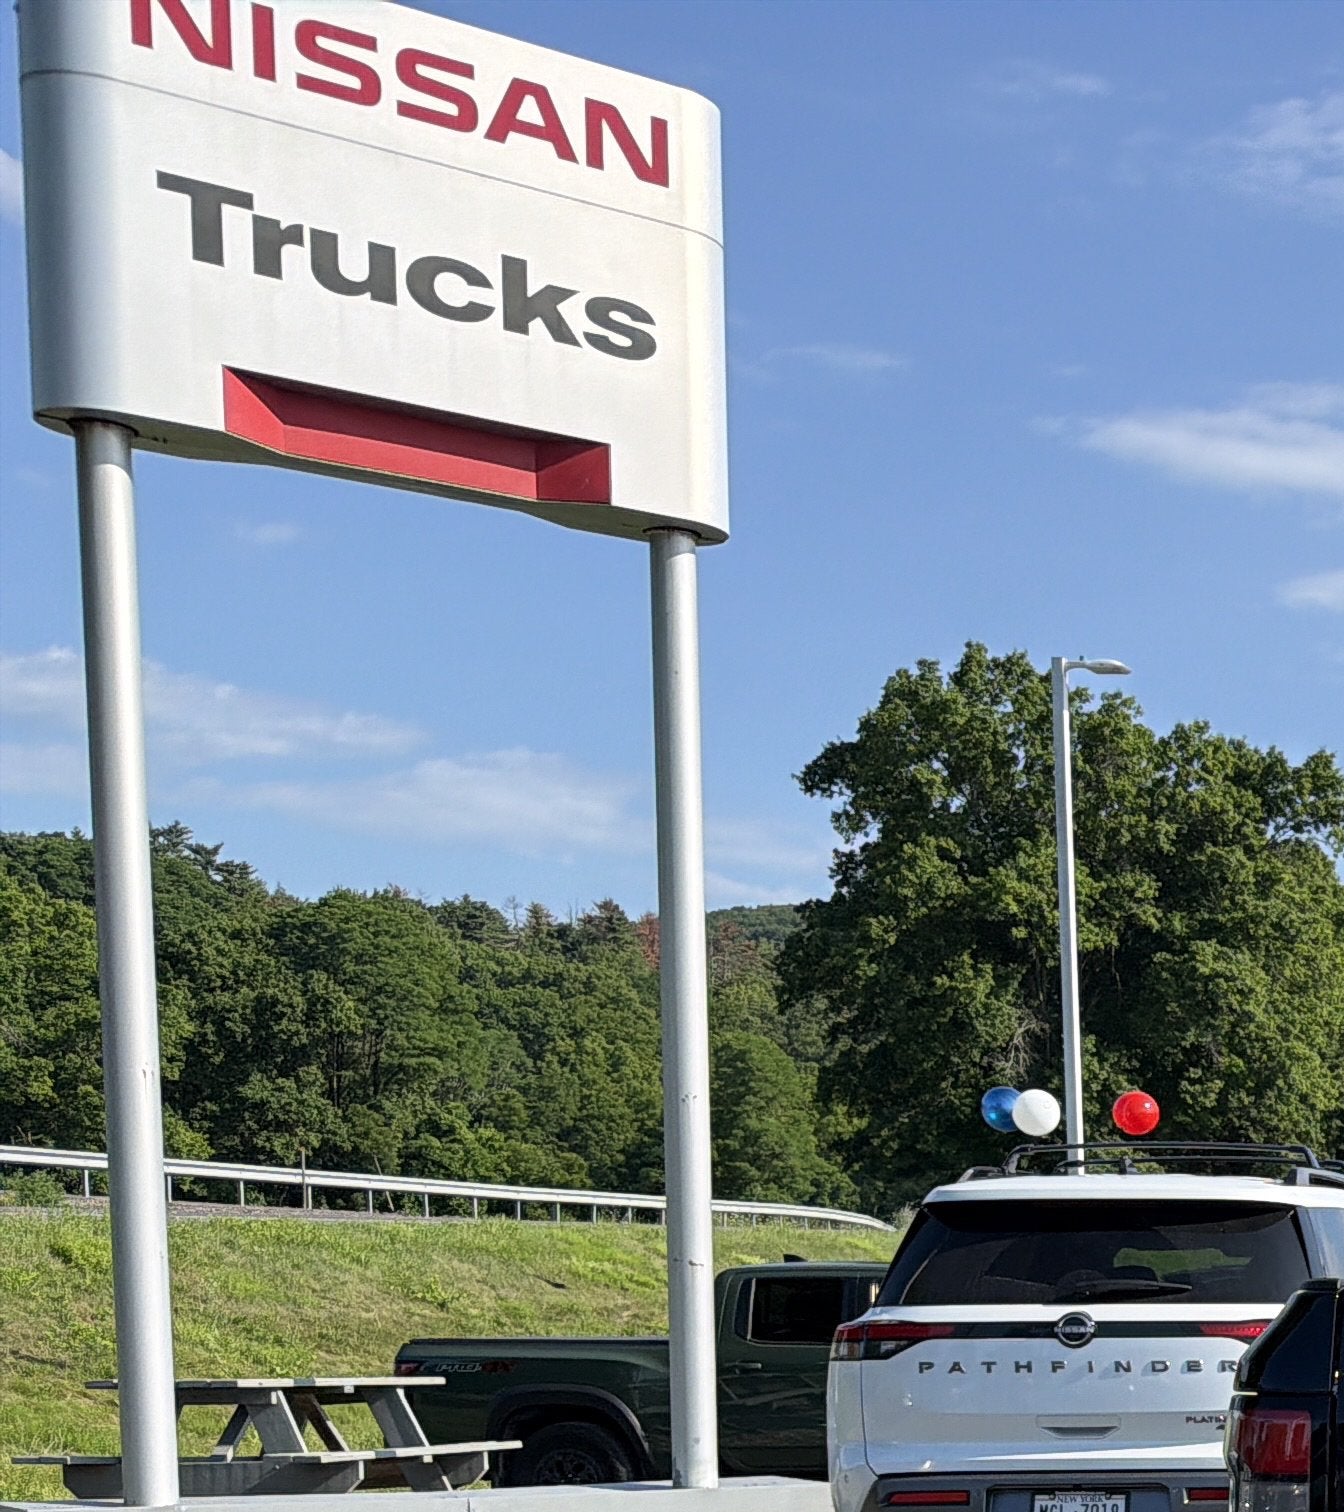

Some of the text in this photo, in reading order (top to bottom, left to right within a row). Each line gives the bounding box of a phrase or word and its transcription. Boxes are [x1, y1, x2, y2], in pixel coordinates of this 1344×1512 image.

[130, 0, 670, 188] NISSAN
[156, 170, 657, 361] Trucks
[918, 1360, 1238, 1375] PATHFINDER
[1185, 1415, 1227, 1424] PLATIN
[1056, 1494, 1104, 1504] NEW YORK
